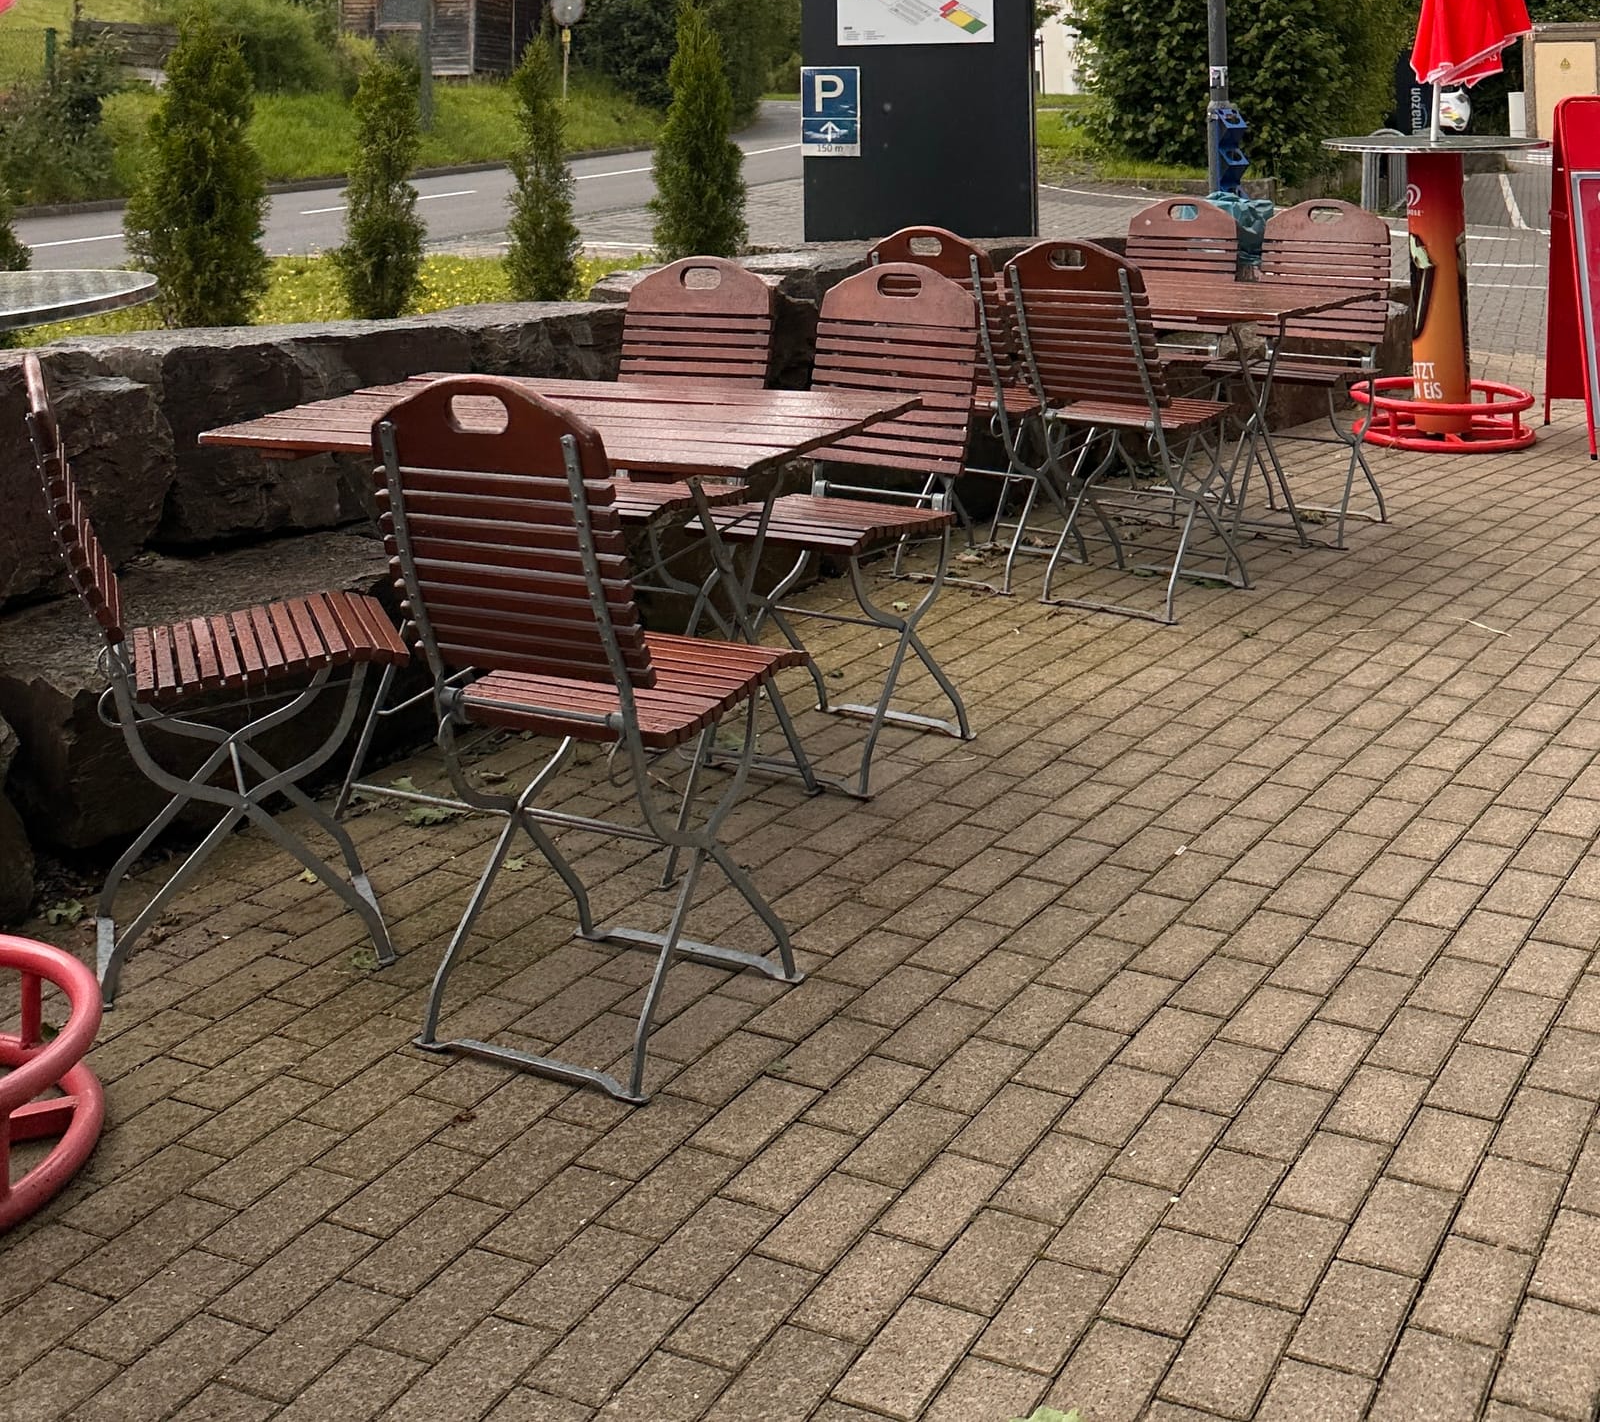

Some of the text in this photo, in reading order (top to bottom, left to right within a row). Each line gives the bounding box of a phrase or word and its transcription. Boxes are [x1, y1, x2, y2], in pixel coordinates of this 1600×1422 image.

[814, 74, 845, 113] P
[817, 144, 844, 153] 150 m
